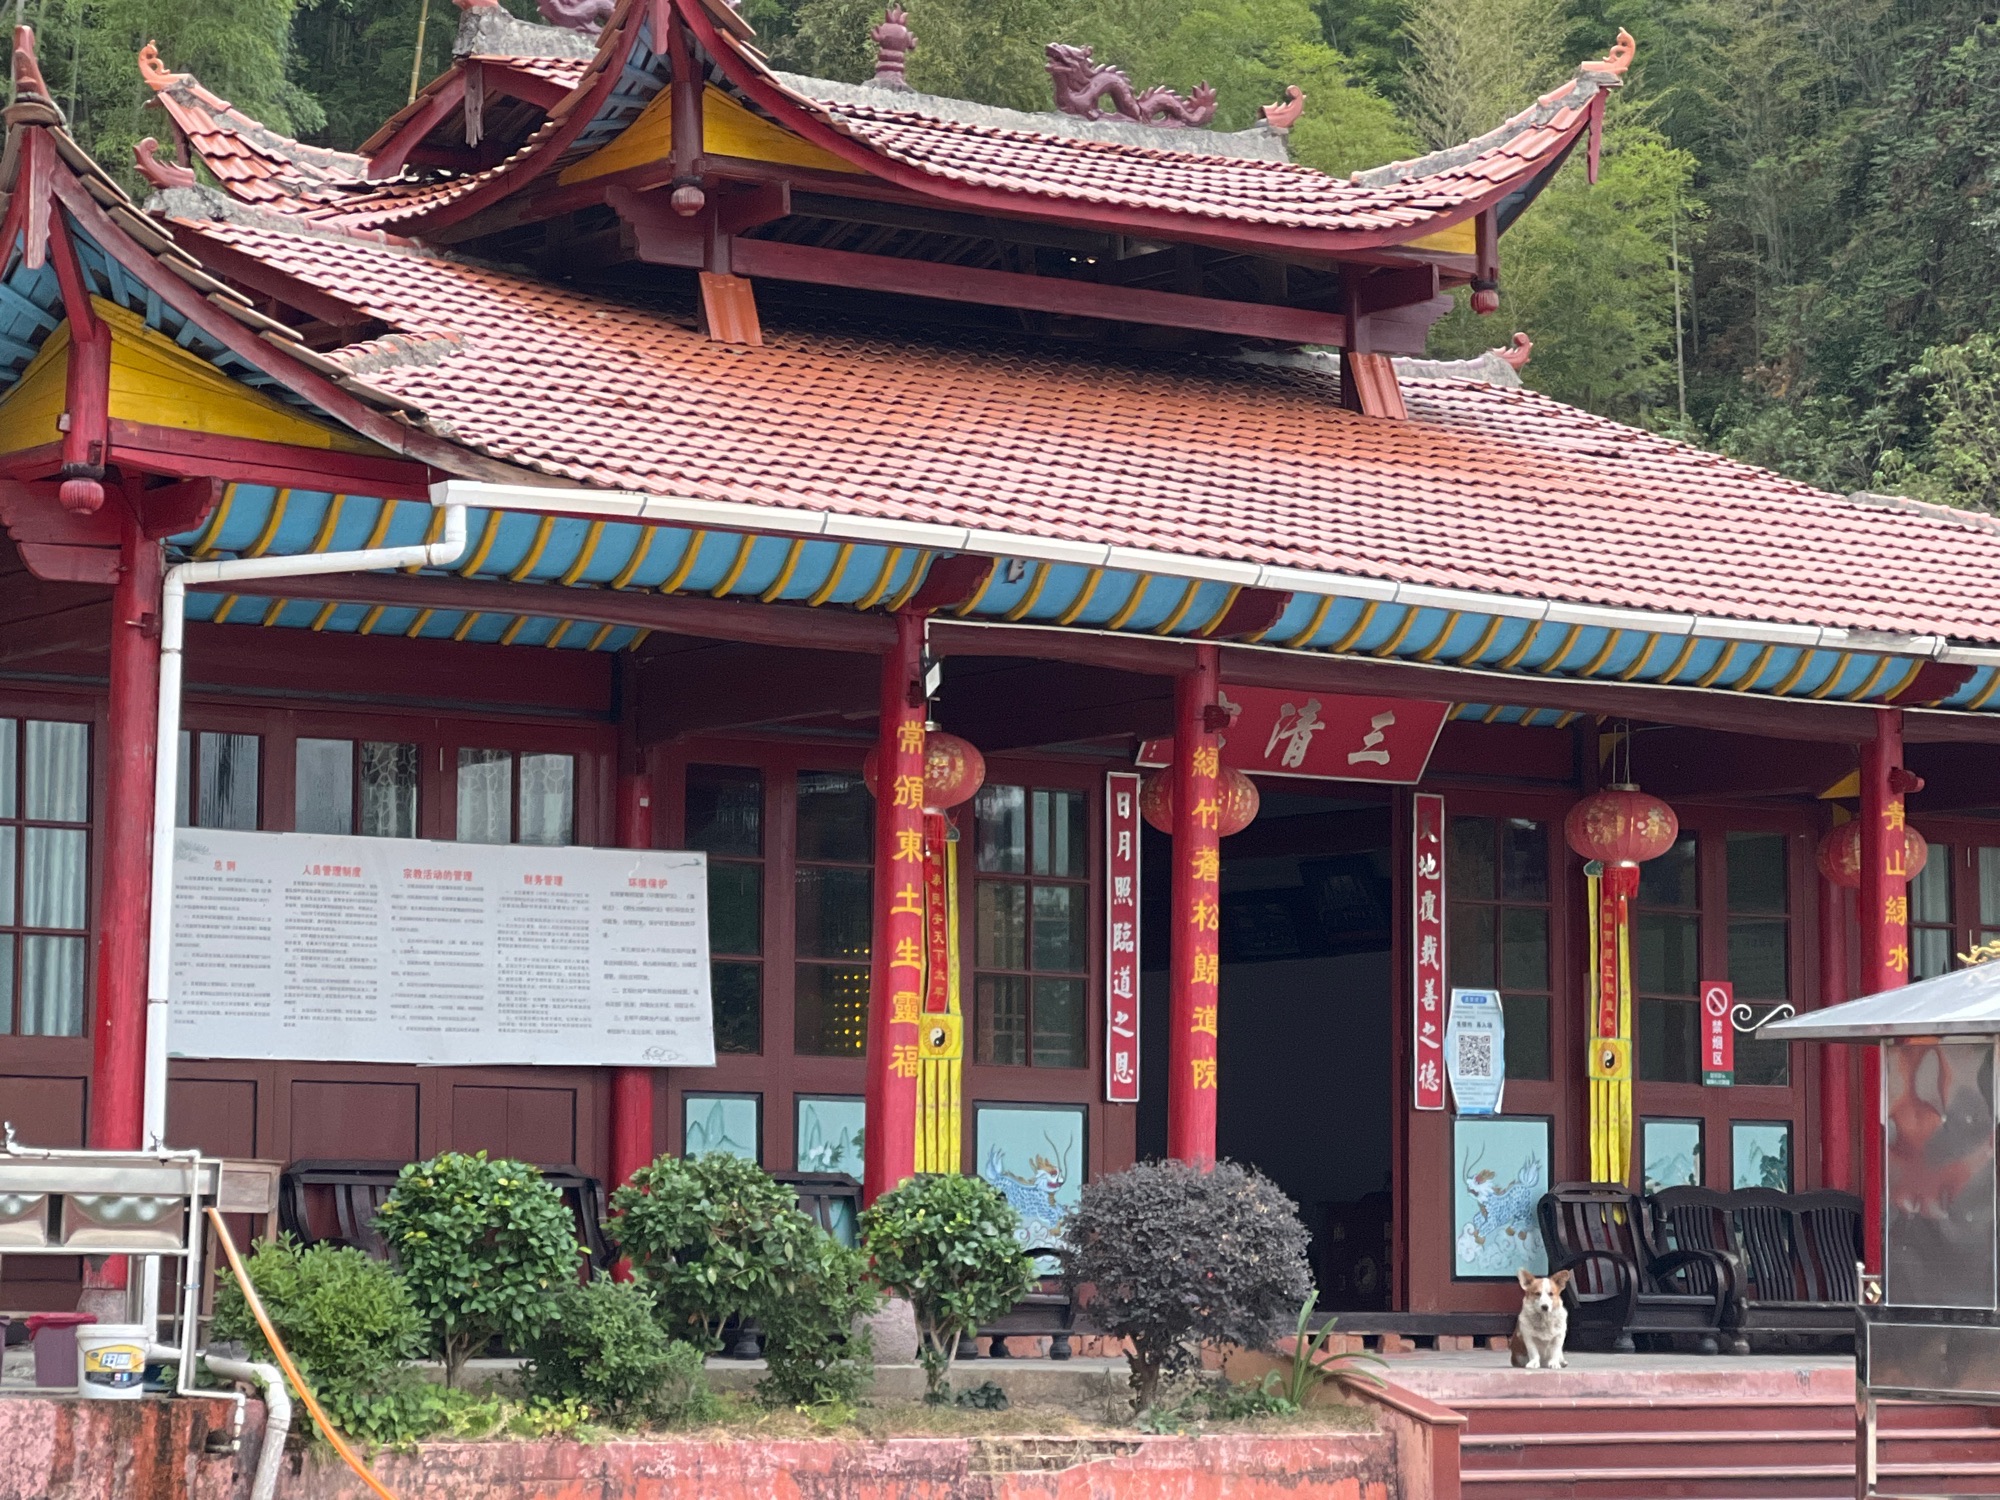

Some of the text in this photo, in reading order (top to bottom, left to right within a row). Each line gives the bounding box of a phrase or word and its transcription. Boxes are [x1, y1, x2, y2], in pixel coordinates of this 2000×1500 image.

[302, 864, 362, 878] 人员管理制度
[403, 868, 473, 882] 宗教活动的管理
[523, 874, 564, 887] 财务管理
[627, 877, 668, 890] 环境保护
[1711, 1020, 1723, 1066] 禁烟区
